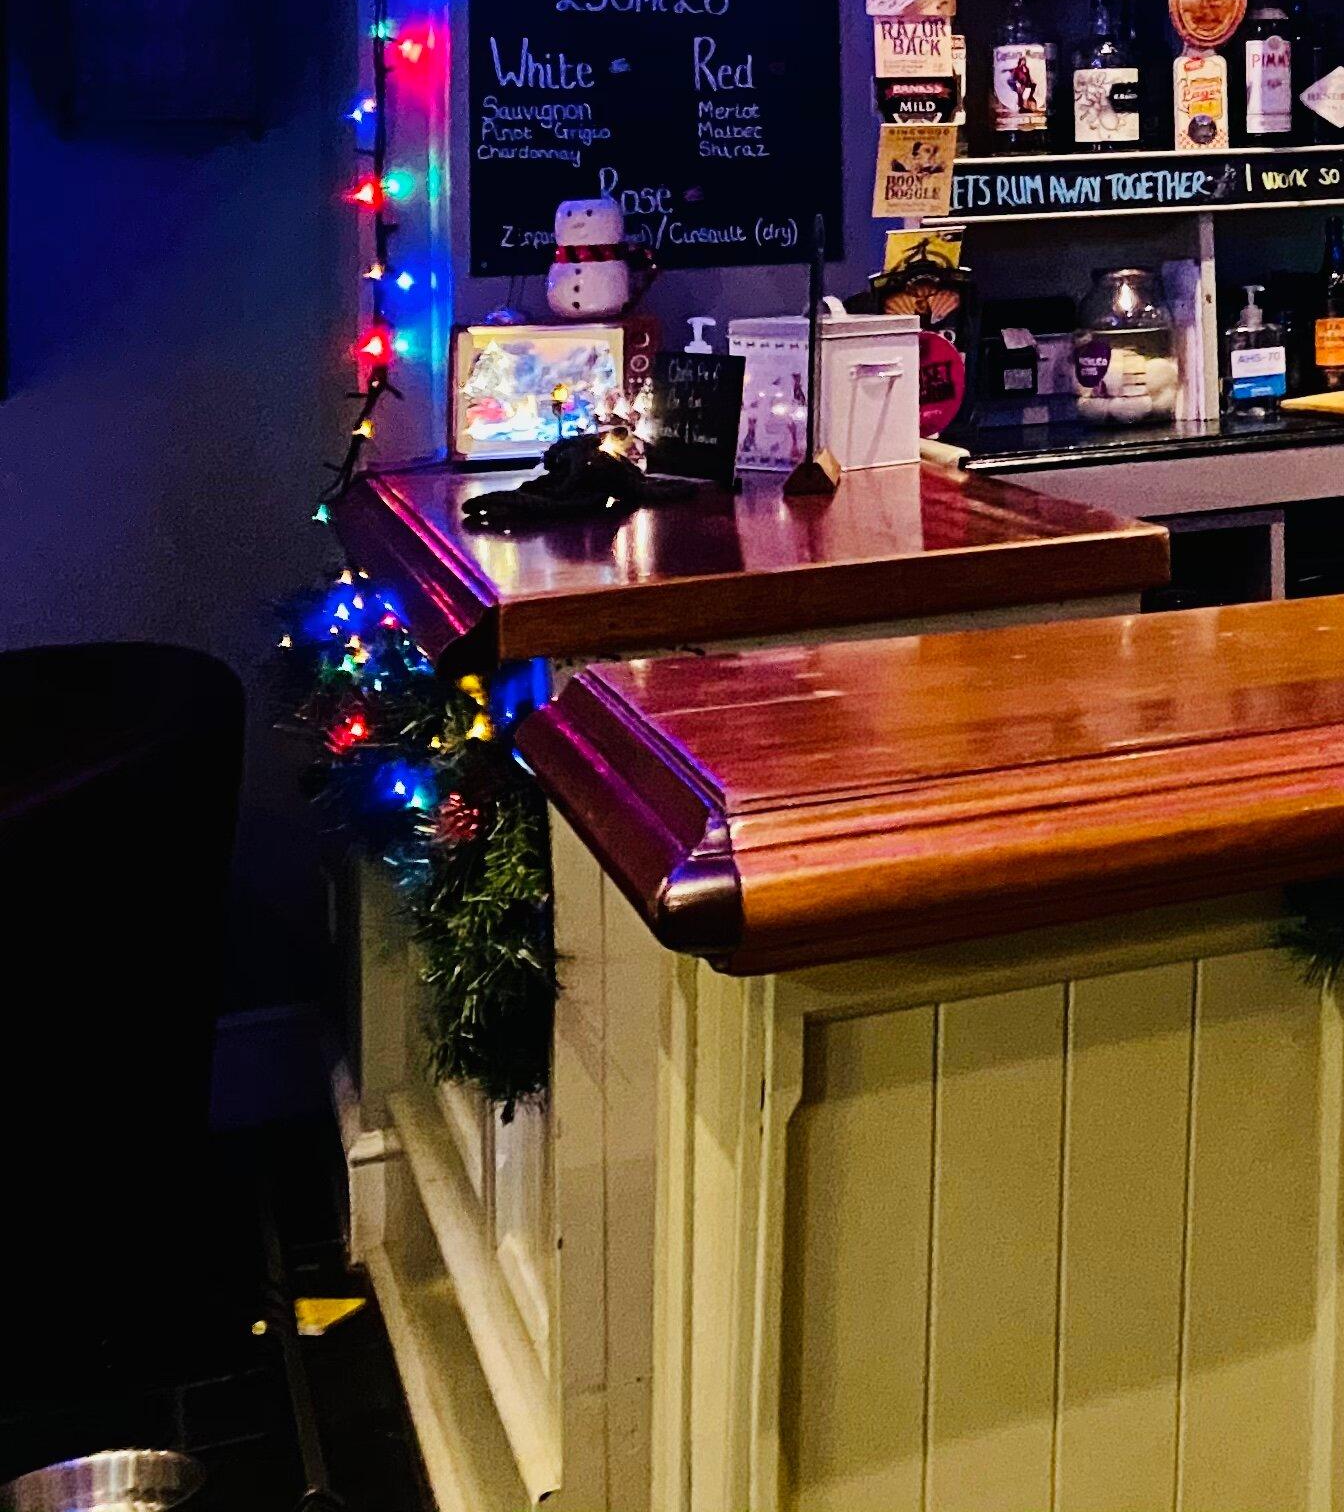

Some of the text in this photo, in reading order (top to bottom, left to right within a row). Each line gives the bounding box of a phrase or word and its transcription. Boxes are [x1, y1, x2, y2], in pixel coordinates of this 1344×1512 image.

[880, 20, 947, 40] RAZOR
[892, 38, 941, 57] BACK
[489, 36, 595, 89] White
[693, 36, 756, 92] Red
[482, 95, 593, 129] Sauvignon
[698, 99, 761, 120] Merlot
[899, 100, 937, 112] MILD
[481, 117, 614, 146] Pinot Grigio
[698, 122, 763, 139] Malbec
[477, 144, 581, 168] Chardonnay
[698, 143, 771, 158] Shiraz
[996, 170, 1211, 207] RUM AWAY TOGETHER
[1244, 162, 1252, 192] I
[1261, 164, 1307, 191] work
[1318, 168, 1341, 186] so
[755, 216, 800, 248] (dry)
